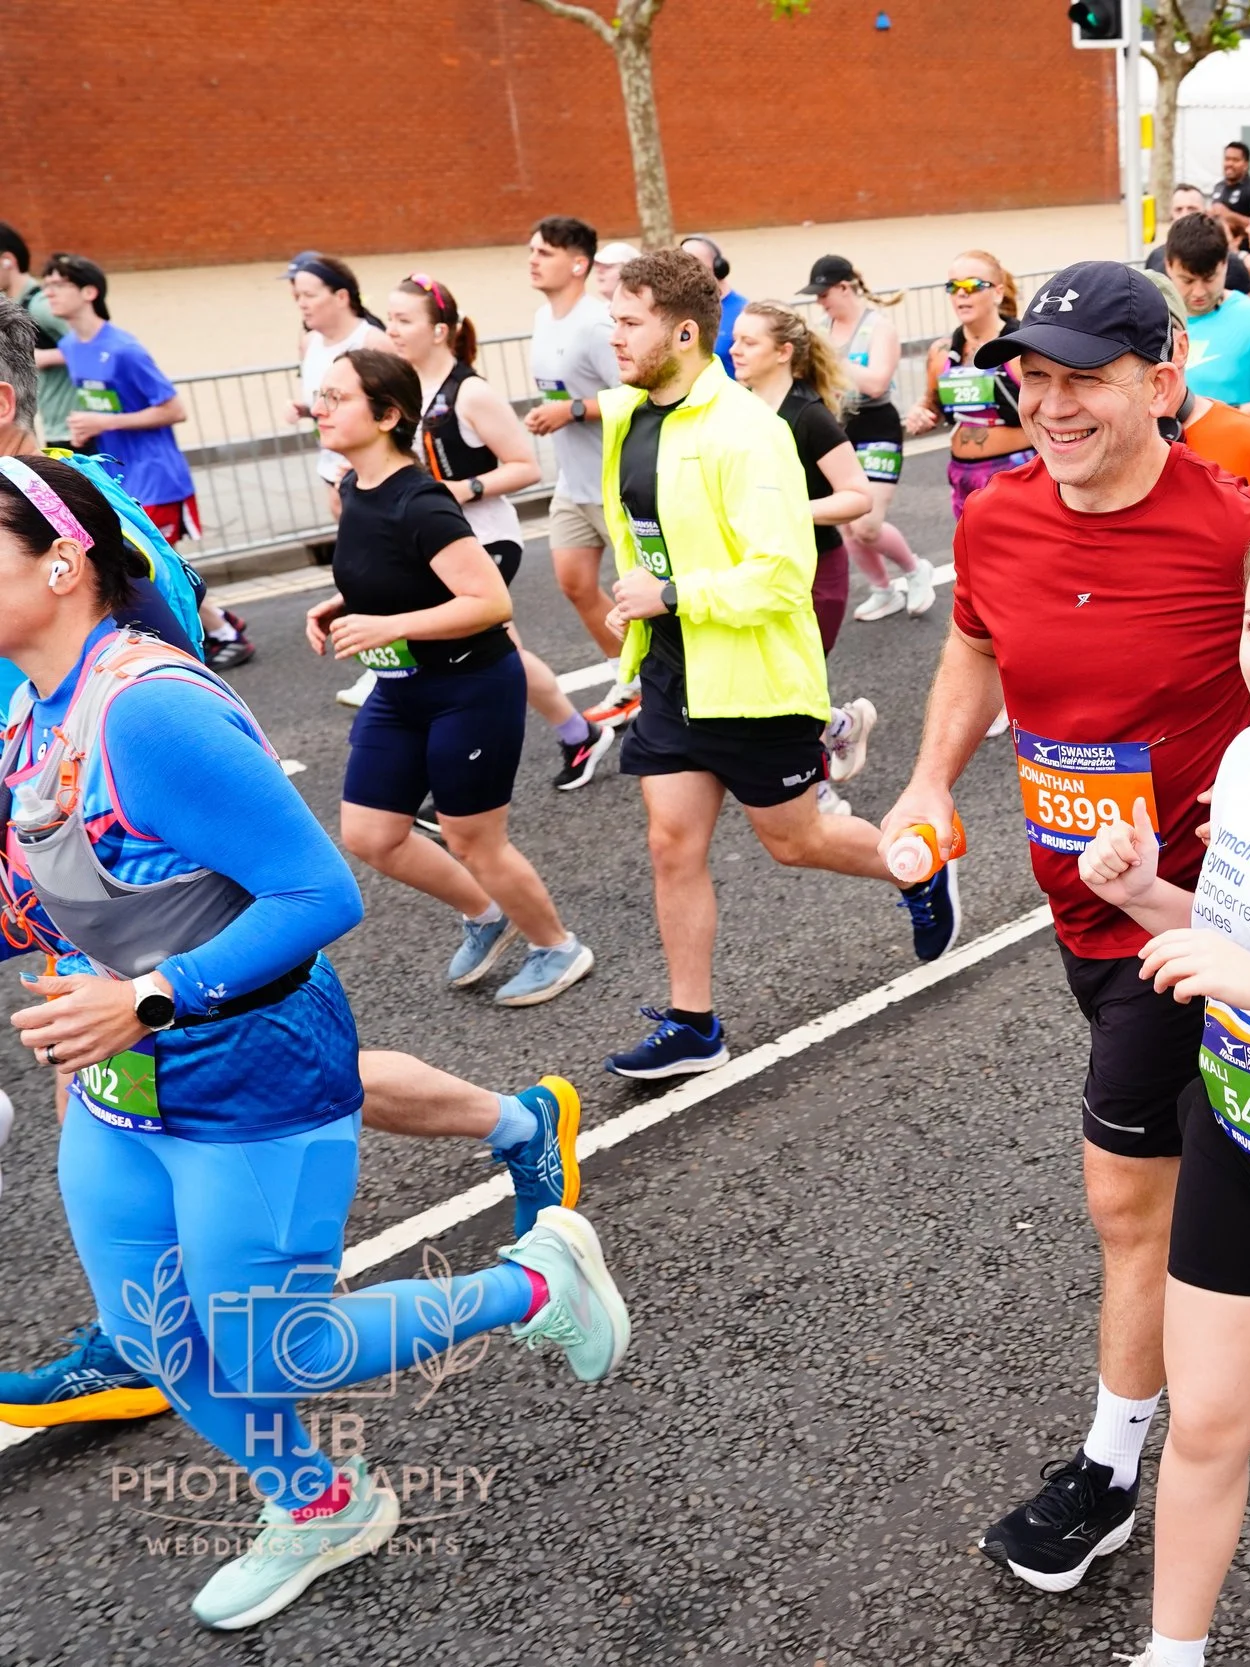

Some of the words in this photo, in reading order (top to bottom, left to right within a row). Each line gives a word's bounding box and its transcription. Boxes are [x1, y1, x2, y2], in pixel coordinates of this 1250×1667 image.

[953, 386, 980, 403] 292
[1060, 745, 1115, 758] SWANSEA
[1020, 764, 1085, 794] JONATHAN
[1038, 788, 1121, 831] 5399
[1207, 852, 1245, 887] cymru
[1199, 875, 1238, 912] cancer
[1194, 902, 1232, 933] wales
[1200, 1052, 1229, 1083] MALI
